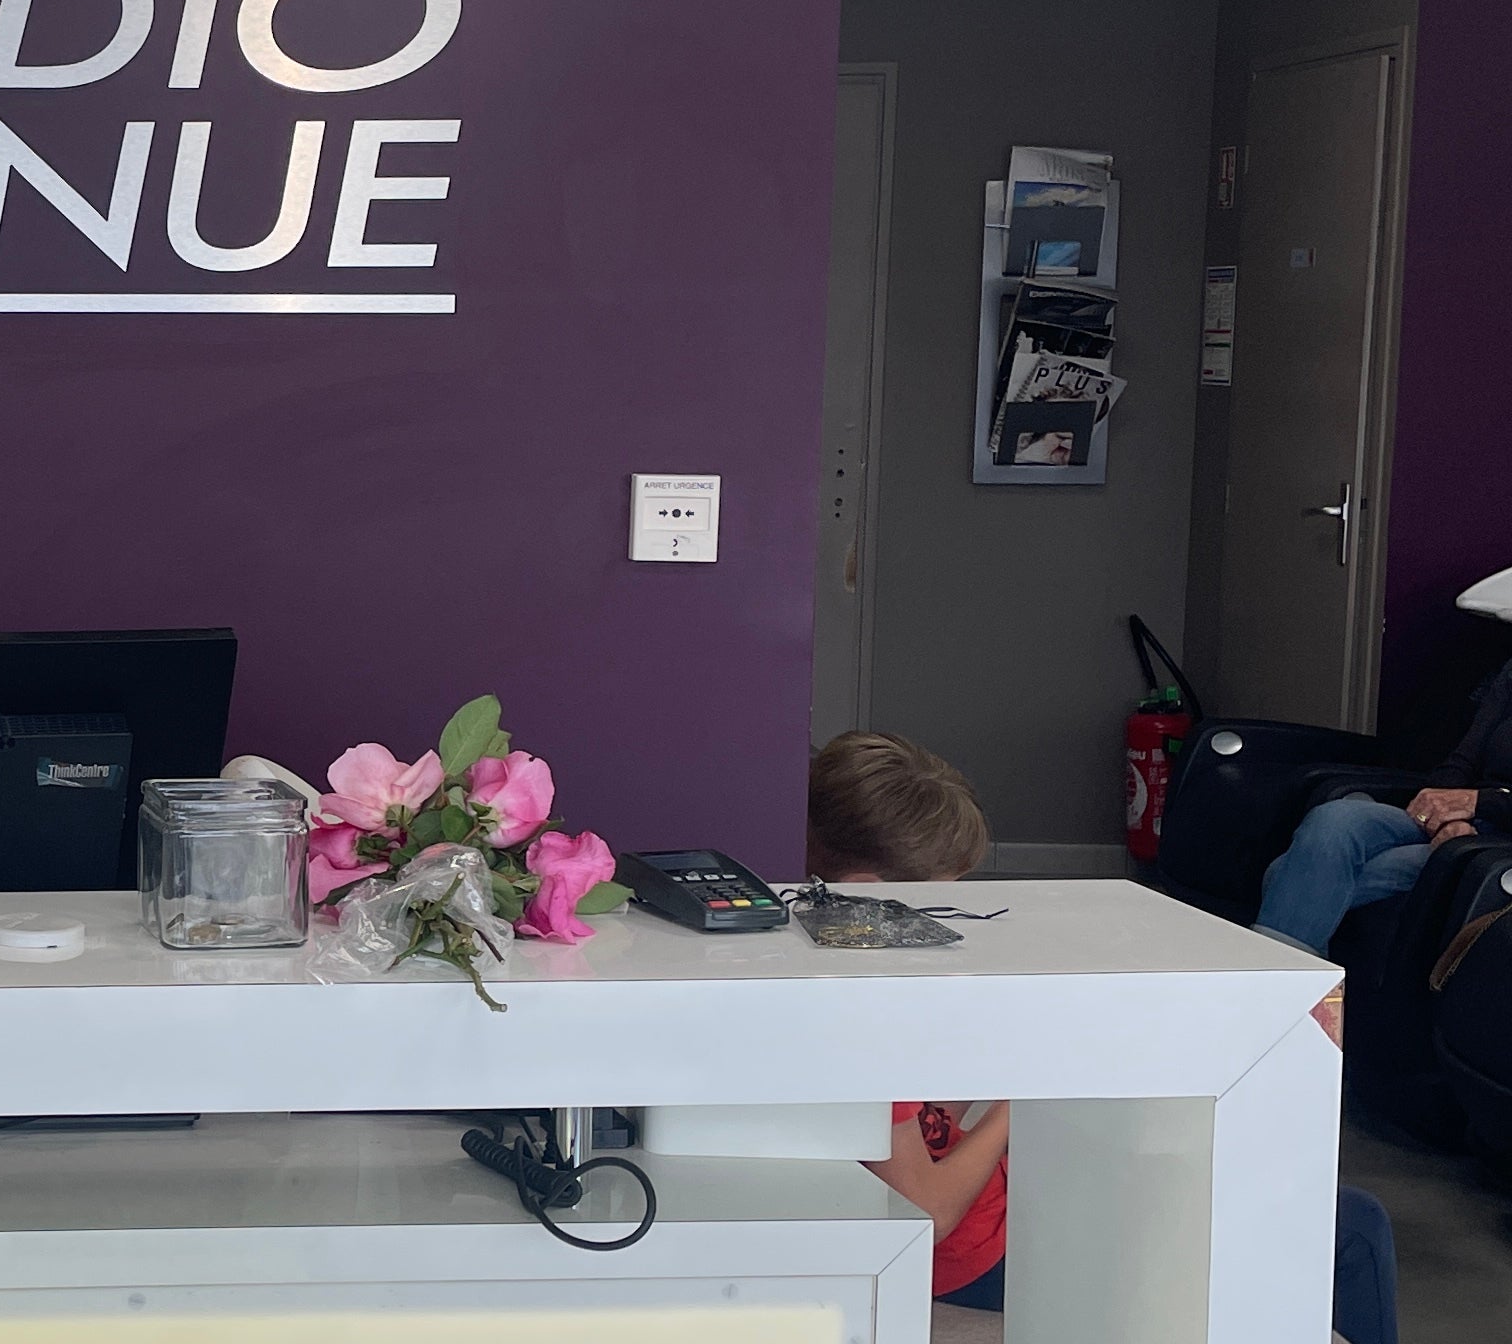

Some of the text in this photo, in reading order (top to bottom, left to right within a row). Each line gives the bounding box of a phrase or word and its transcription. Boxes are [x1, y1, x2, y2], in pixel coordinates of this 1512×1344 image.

[1033, 367, 1113, 395] PLUS
[673, 481, 715, 490] URGENCE
[48, 763, 110, 779] ThinkCentre
